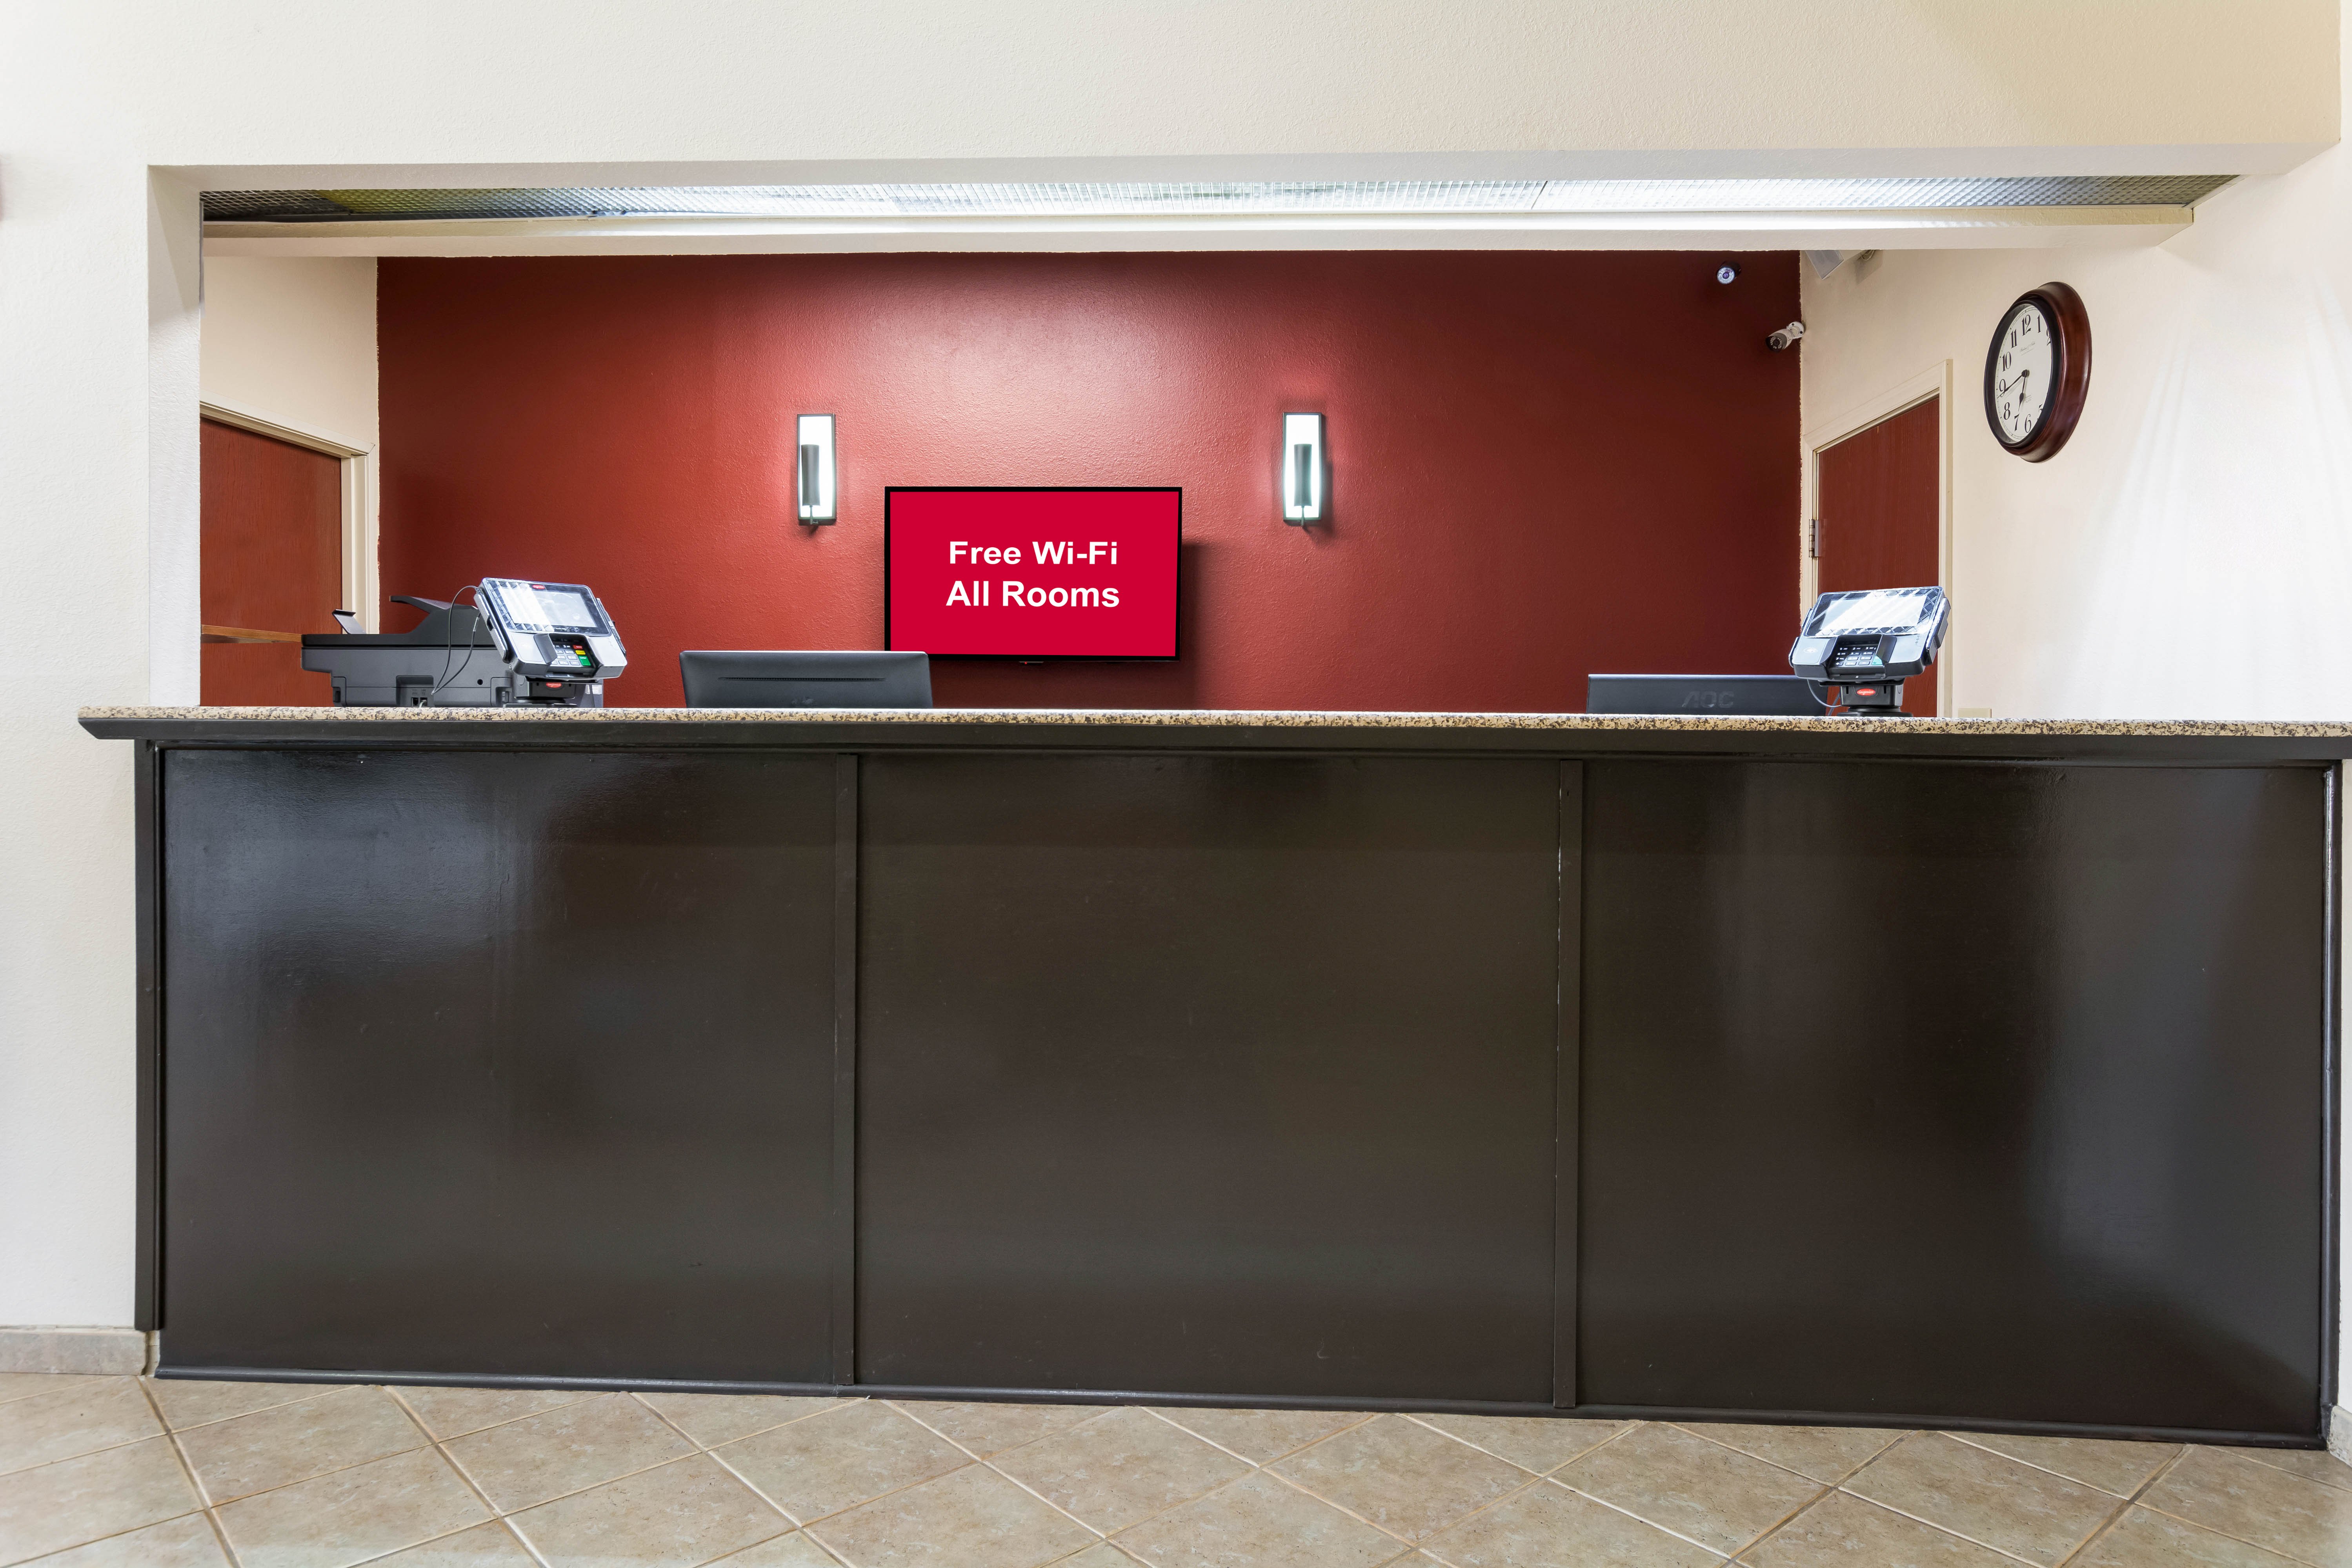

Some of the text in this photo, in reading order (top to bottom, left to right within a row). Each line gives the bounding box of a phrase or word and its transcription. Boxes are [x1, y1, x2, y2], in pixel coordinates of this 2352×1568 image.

[2021, 314, 2032, 336] 12
[2037, 314, 2041, 333] 1
[2010, 329, 2017, 349] 11
[2002, 351, 2012, 372] 10
[1999, 379, 2006, 397] 9
[2003, 402, 2010, 420] 8
[2014, 413, 2020, 431] 7
[2025, 414, 2032, 433] 6
[949, 541, 1117, 565] Free Wi-Fi
[946, 580, 1119, 608] All Rooms
[1682, 691, 1734, 708] AOC
